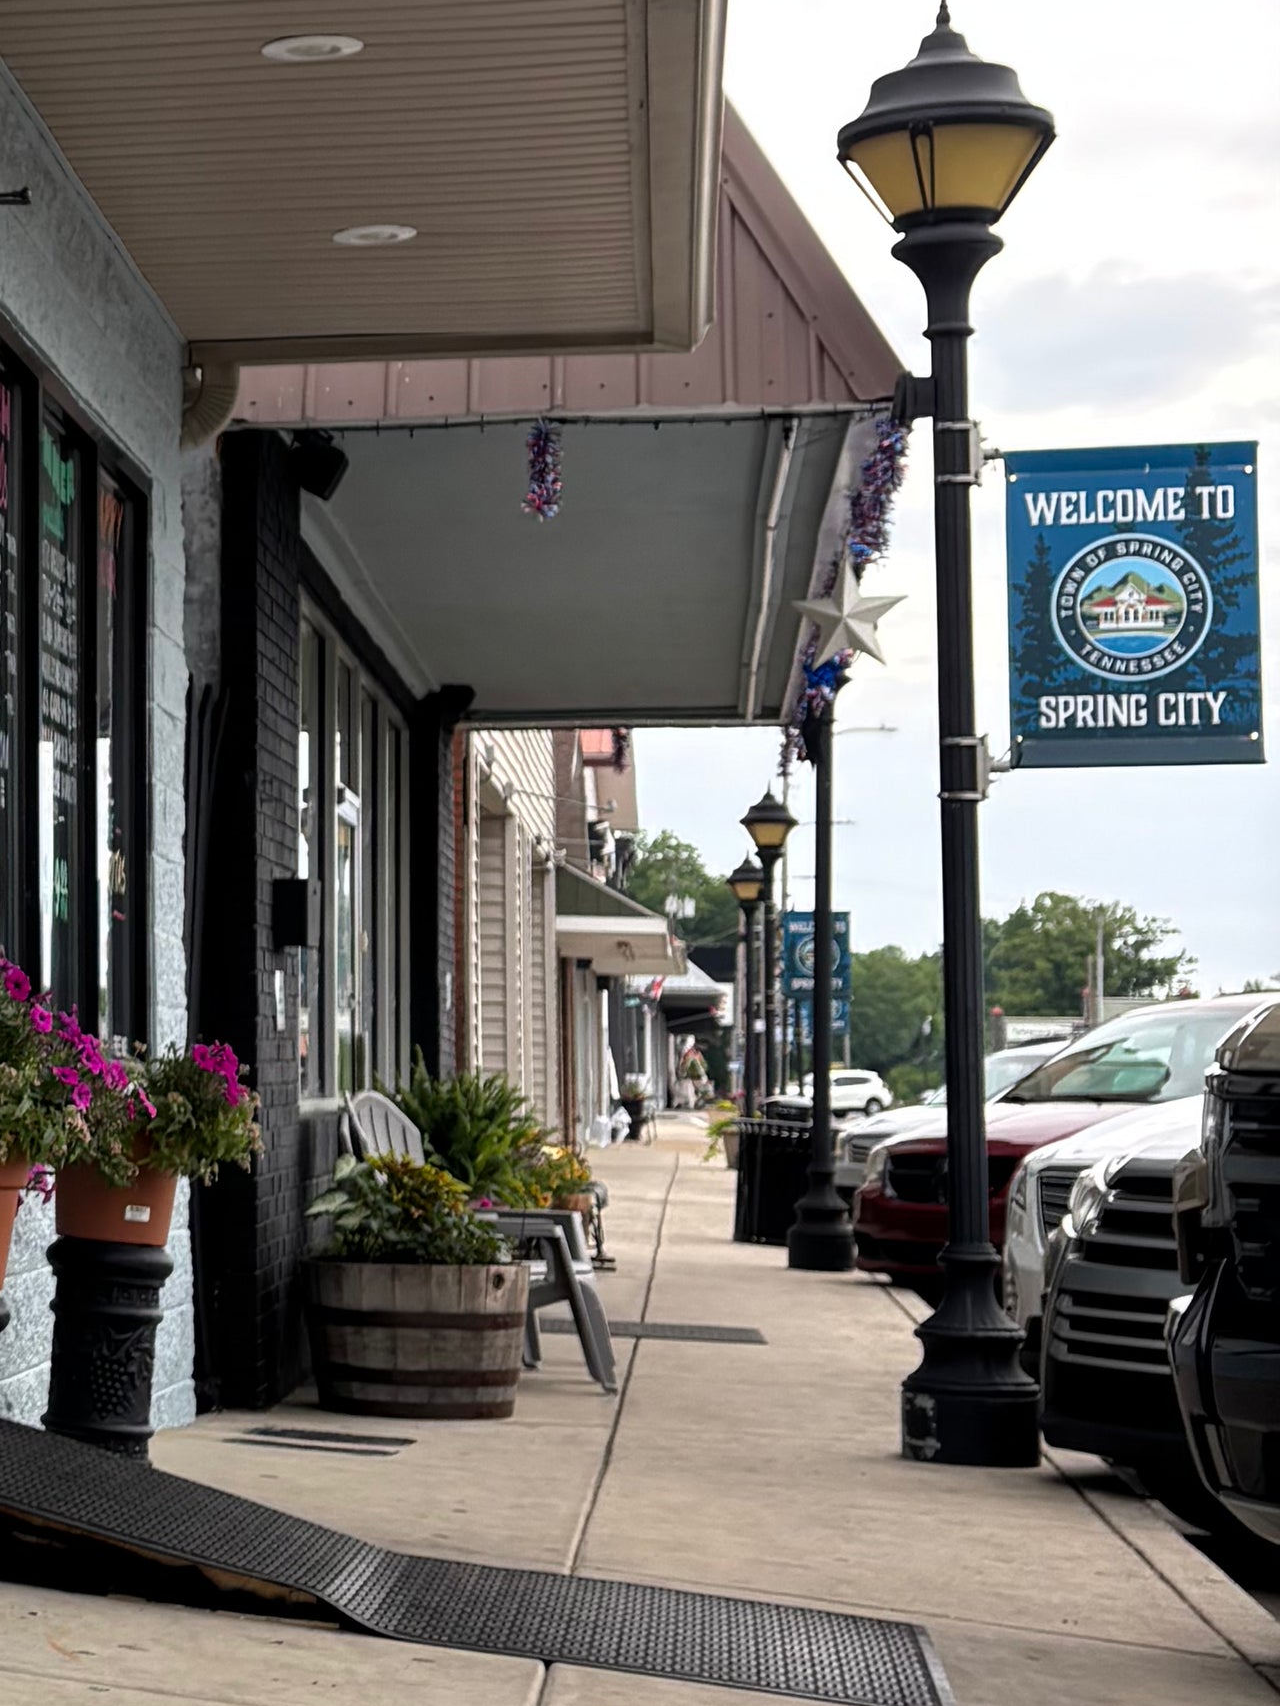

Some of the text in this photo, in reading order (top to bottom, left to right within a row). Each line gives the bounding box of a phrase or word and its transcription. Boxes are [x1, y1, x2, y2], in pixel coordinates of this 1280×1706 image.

[1024, 484, 1236, 527] WELCOME TO
[1060, 541, 1204, 619] TOWN OF SPRING CITY
[1079, 639, 1187, 674] TENNESSEE
[1038, 690, 1228, 729] SPRING CITY
